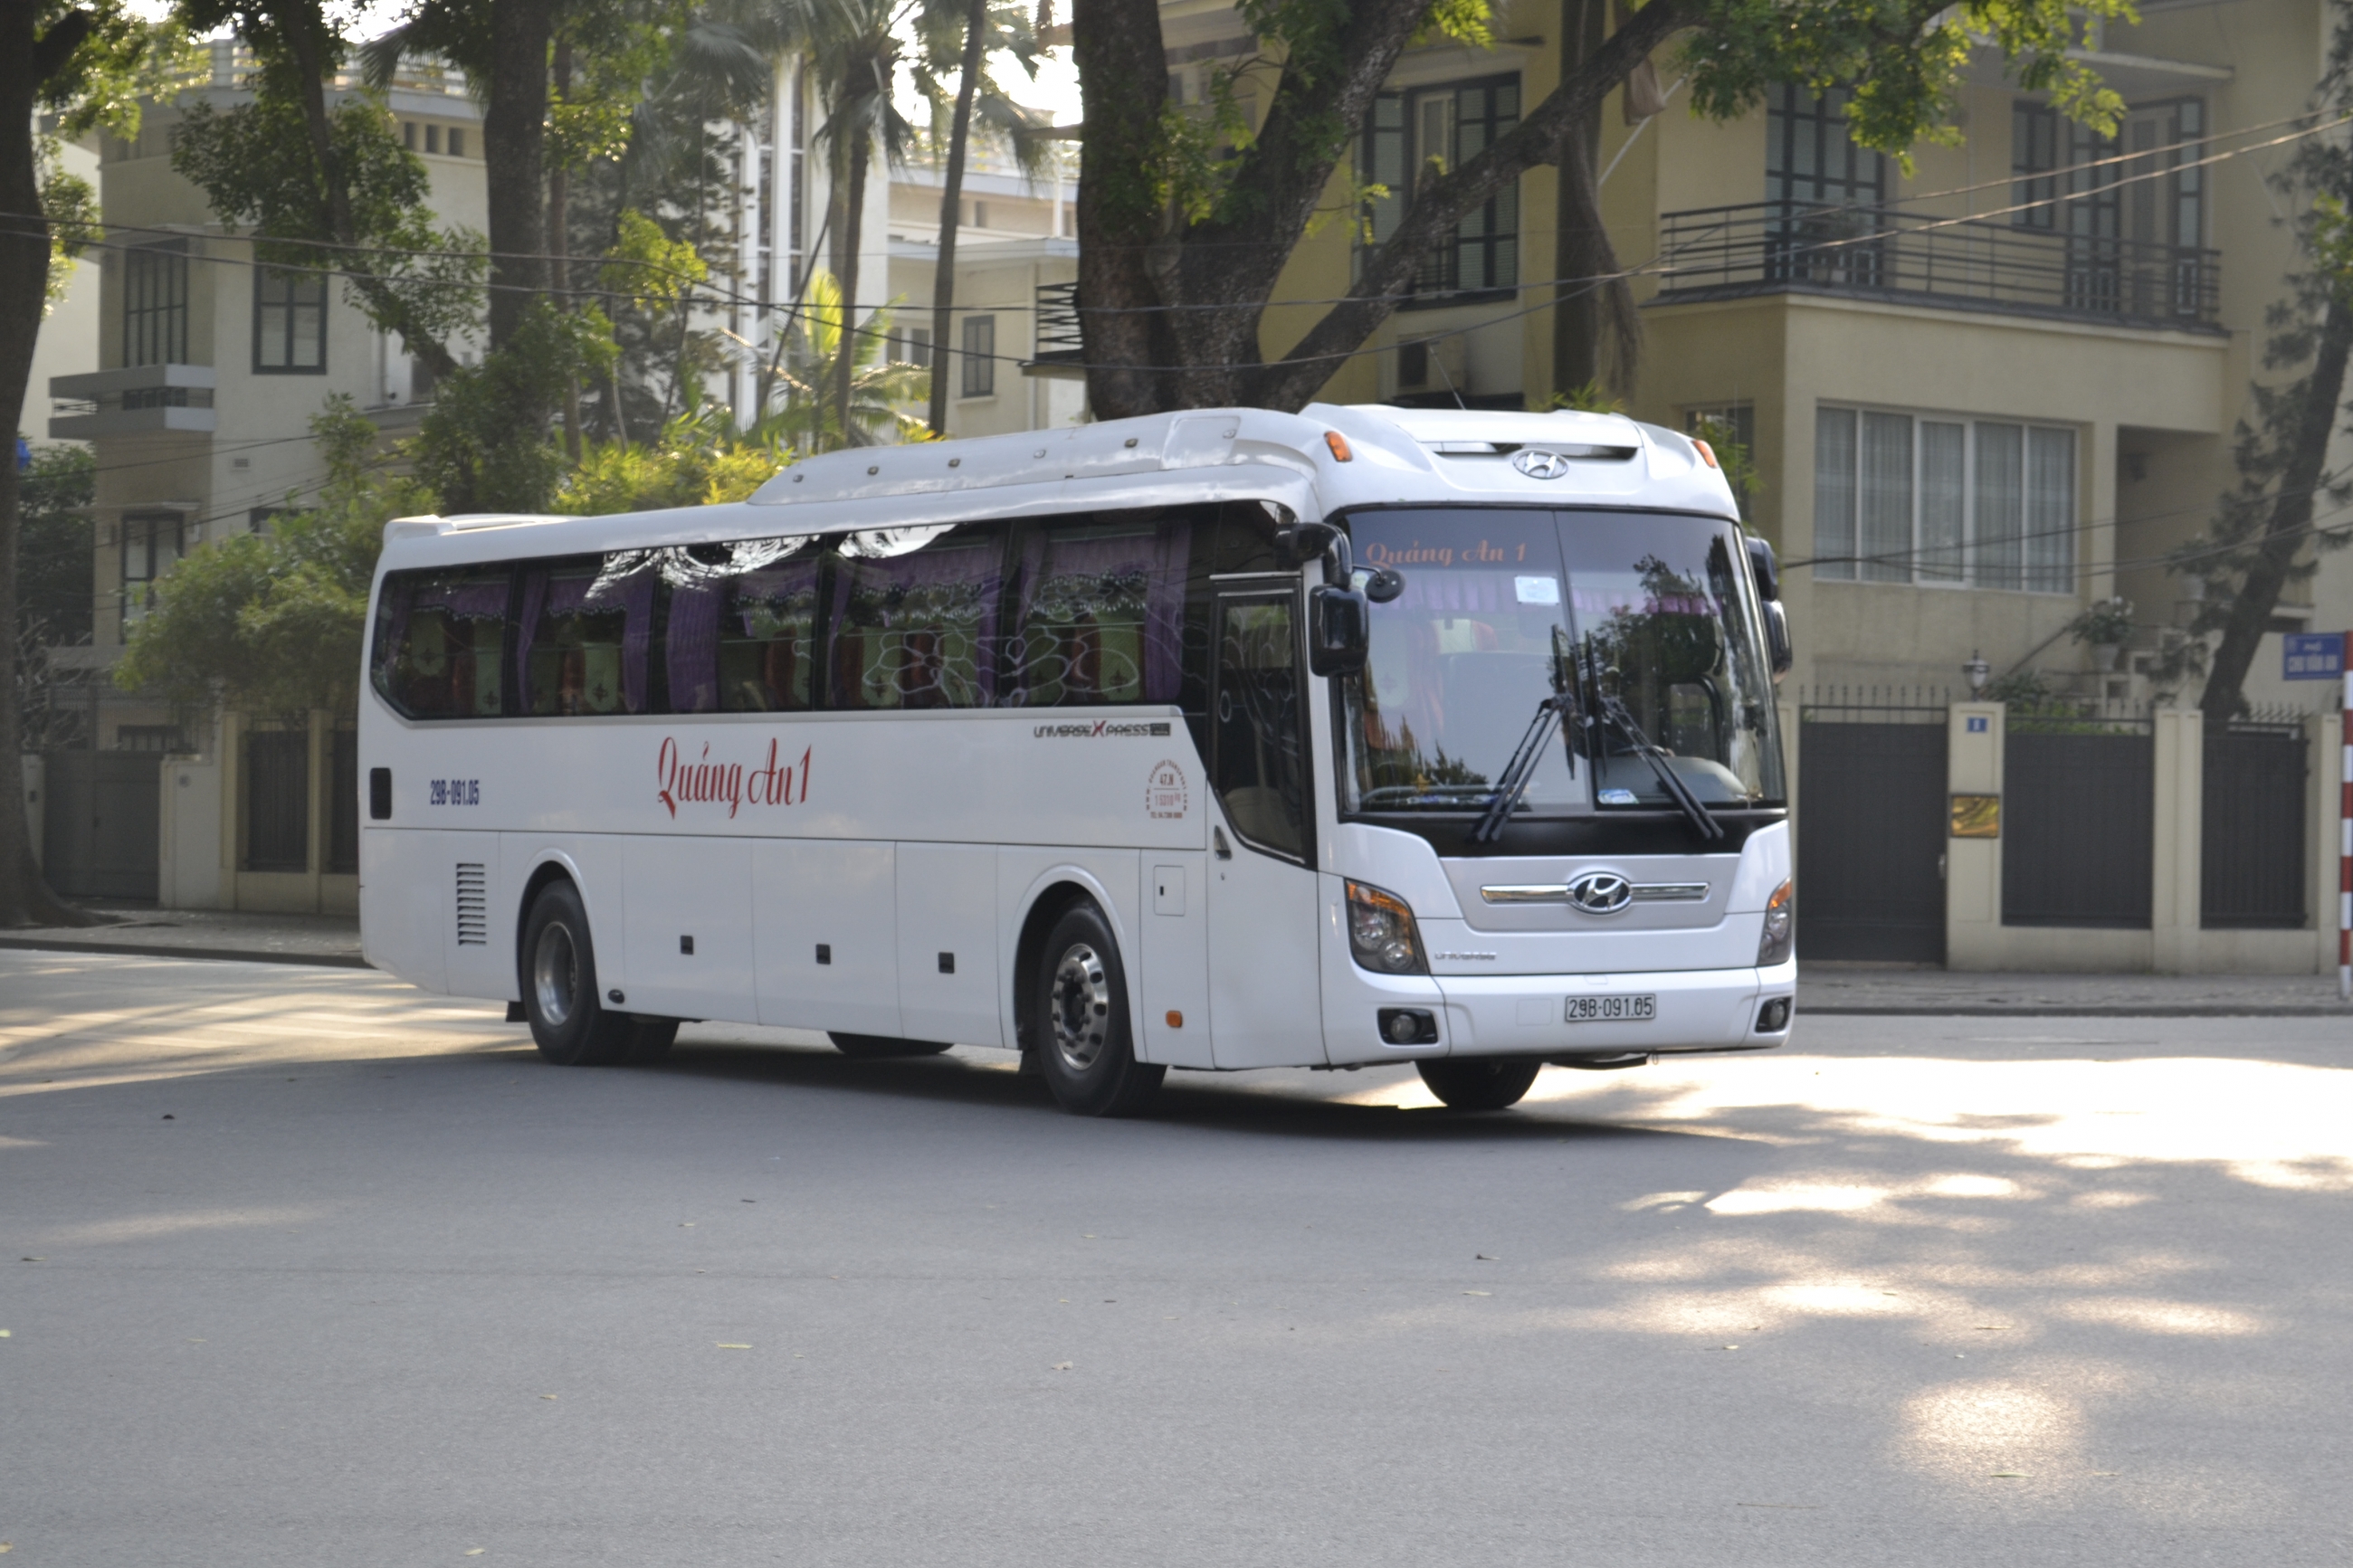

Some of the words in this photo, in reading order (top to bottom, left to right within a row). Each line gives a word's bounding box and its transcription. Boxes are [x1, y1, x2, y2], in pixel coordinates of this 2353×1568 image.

[1366, 540, 1453, 570] Quảng
[1462, 539, 1504, 563] An
[1515, 543, 1527, 563] 1
[430, 779, 480, 805] 29B-091.05
[658, 736, 744, 820] Quảng
[748, 737, 795, 805] An
[799, 744, 812, 804] 1
[1568, 997, 1653, 1019] 29B-091.05
